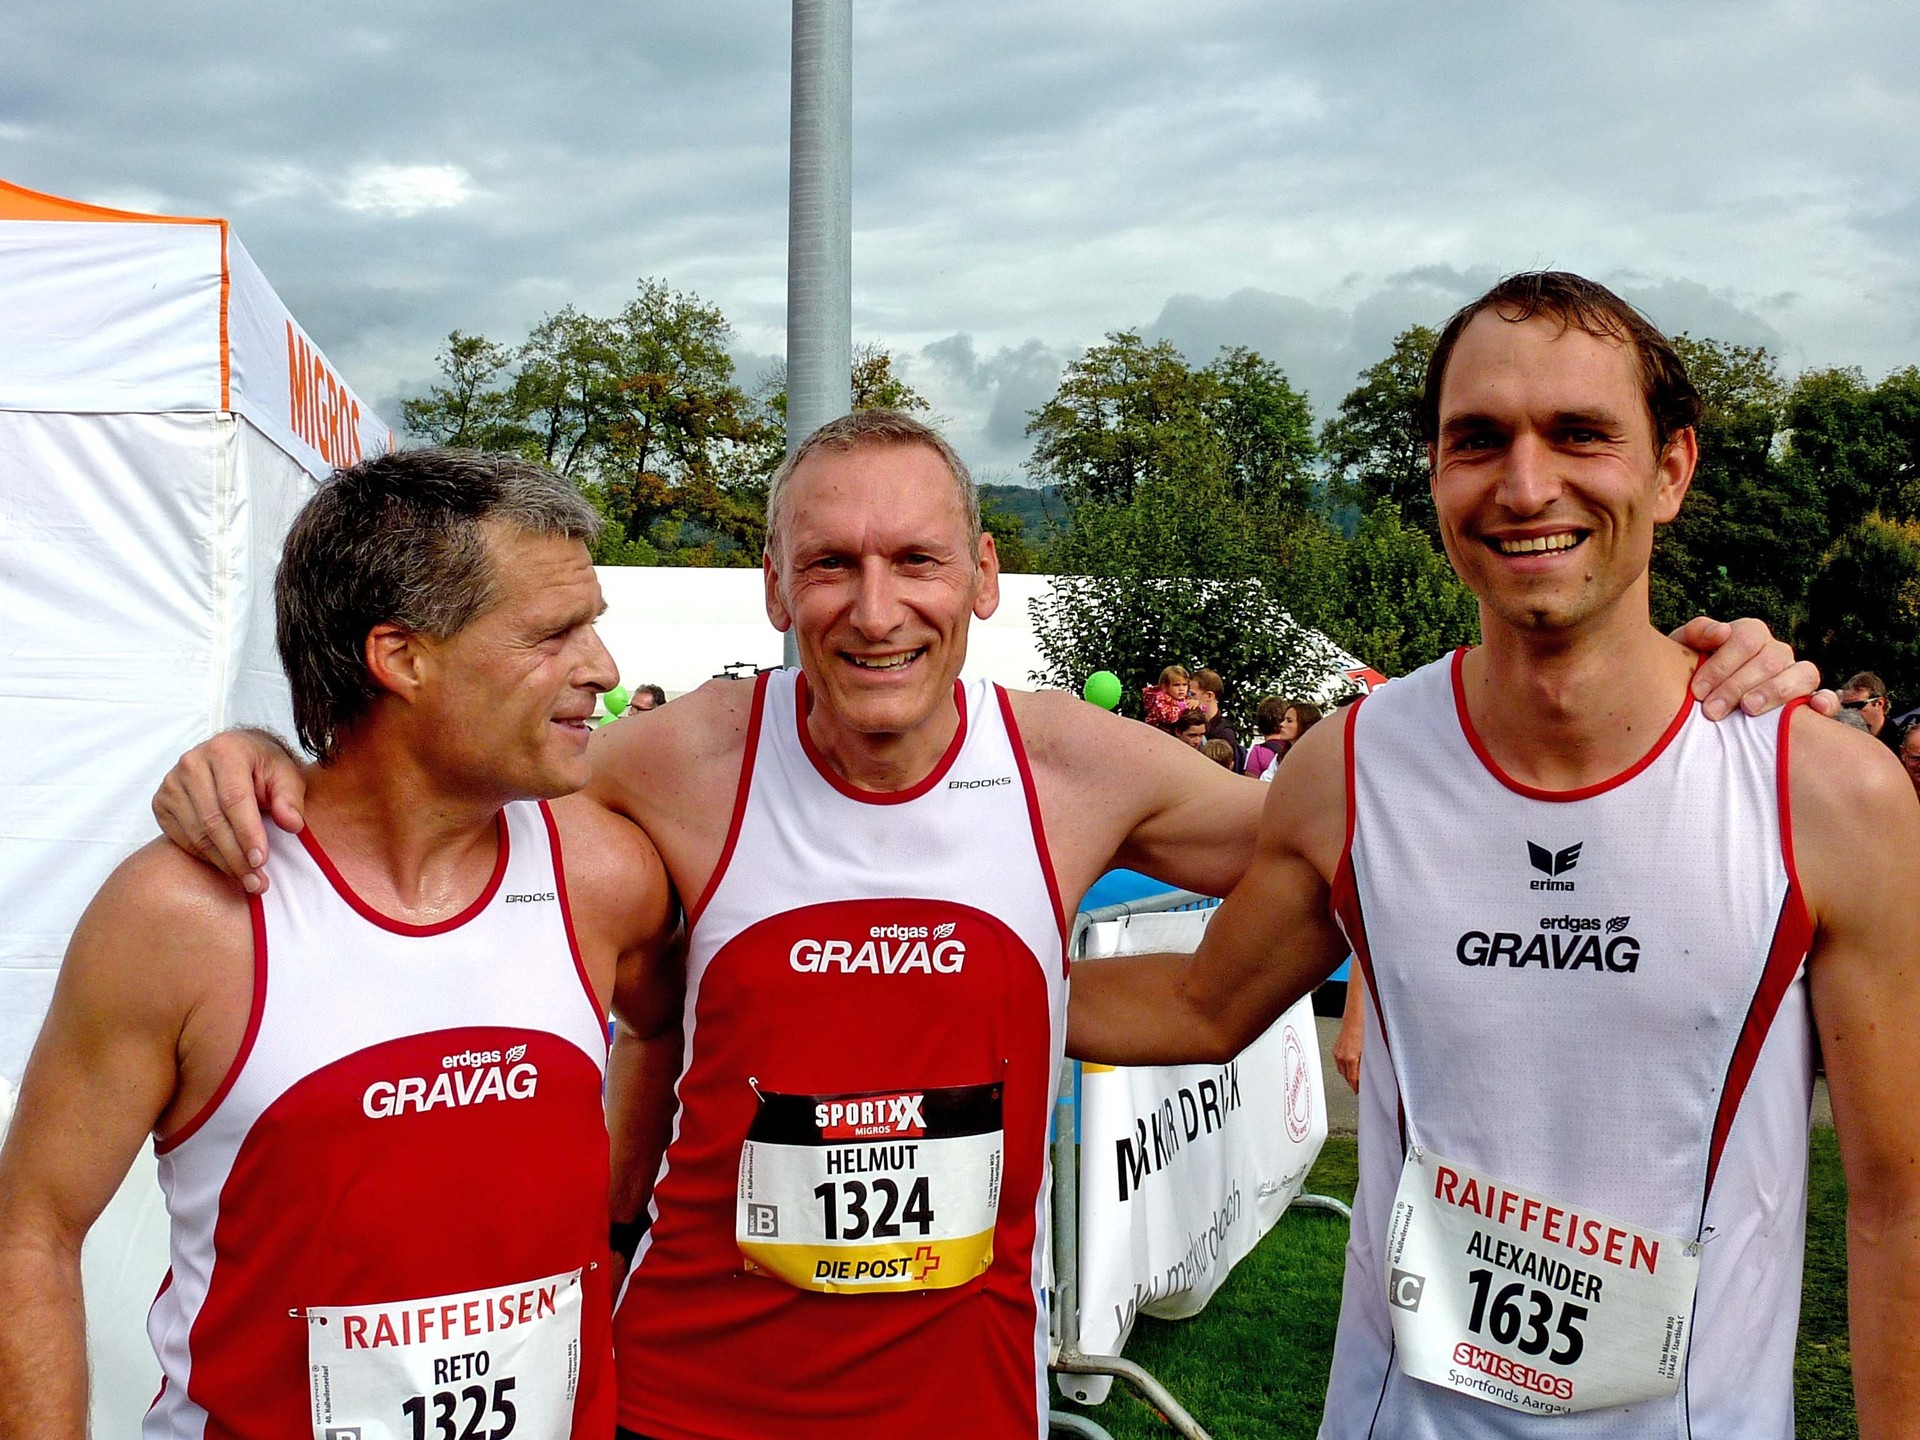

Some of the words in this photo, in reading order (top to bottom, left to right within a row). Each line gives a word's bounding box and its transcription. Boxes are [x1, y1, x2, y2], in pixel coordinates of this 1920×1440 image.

[286, 319, 362, 469] MIGROS
[948, 777, 1012, 789] BROOKS
[1529, 878, 1575, 892] erima
[869, 923, 929, 939] erdgas
[1539, 914, 1602, 933] erdgas
[789, 938, 966, 975] GRAVAG
[1456, 930, 1641, 974] GRAVAG
[442, 1048, 502, 1069] erdgas
[362, 1063, 538, 1119] GRAVAG
[815, 1094, 928, 1131] SPORTXX
[854, 1126, 891, 1137] MIGROS
[826, 1144, 919, 1175] HELMUT
[757, 1206, 775, 1234] B
[813, 1176, 935, 1240] 1324
[1433, 1165, 1661, 1276] RAIFFEISEN
[816, 1260, 850, 1280] DIE
[854, 1257, 913, 1280] POST
[1465, 1230, 1604, 1304] ALEXANDER
[1397, 1276, 1420, 1307] C
[342, 1284, 557, 1351] RAIFFEISEN
[1467, 1268, 1589, 1366] 1635
[433, 1350, 490, 1386] RETO
[1447, 1368, 1519, 1404] Sportfonds
[1452, 1342, 1574, 1400] SWISSLOS
[402, 1376, 518, 1440] 1325
